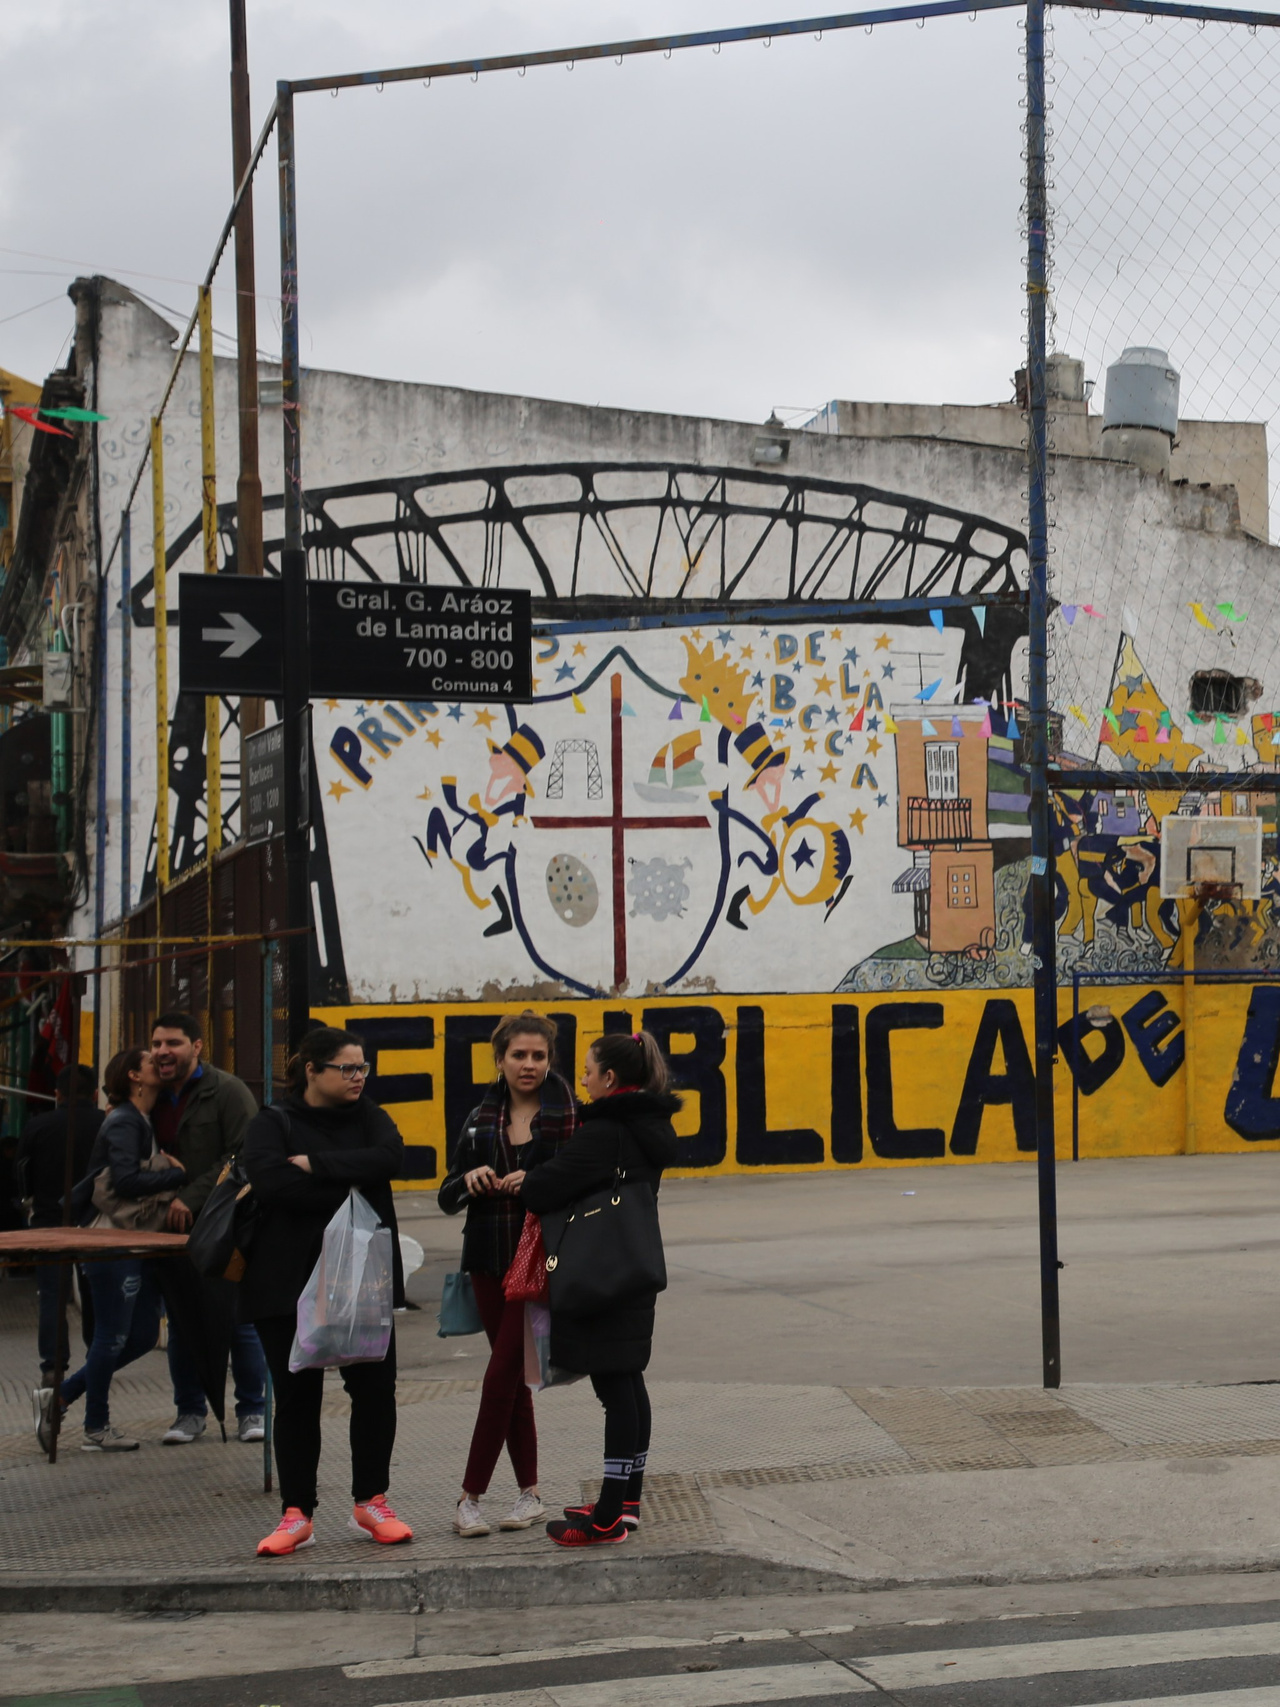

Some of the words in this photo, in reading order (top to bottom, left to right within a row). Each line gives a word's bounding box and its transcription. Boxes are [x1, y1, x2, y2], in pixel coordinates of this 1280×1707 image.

[336, 588, 397, 610] Gral.
[405, 590, 432, 612] G.
[440, 592, 513, 615] Aráoz
[356, 617, 387, 637] de
[395, 618, 513, 642] Lamadrid
[403, 648, 447, 668] 700
[471, 650, 514, 669] 800
[773, 630, 826, 667] DE
[431, 677, 499, 692] Comuna
[503, 679, 513, 693] 4
[839, 663, 884, 711] LA
[266, 729, 282, 753] Valle
[249, 763, 274, 787] Iberlucea
[1057, 990, 1185, 1096] DE
